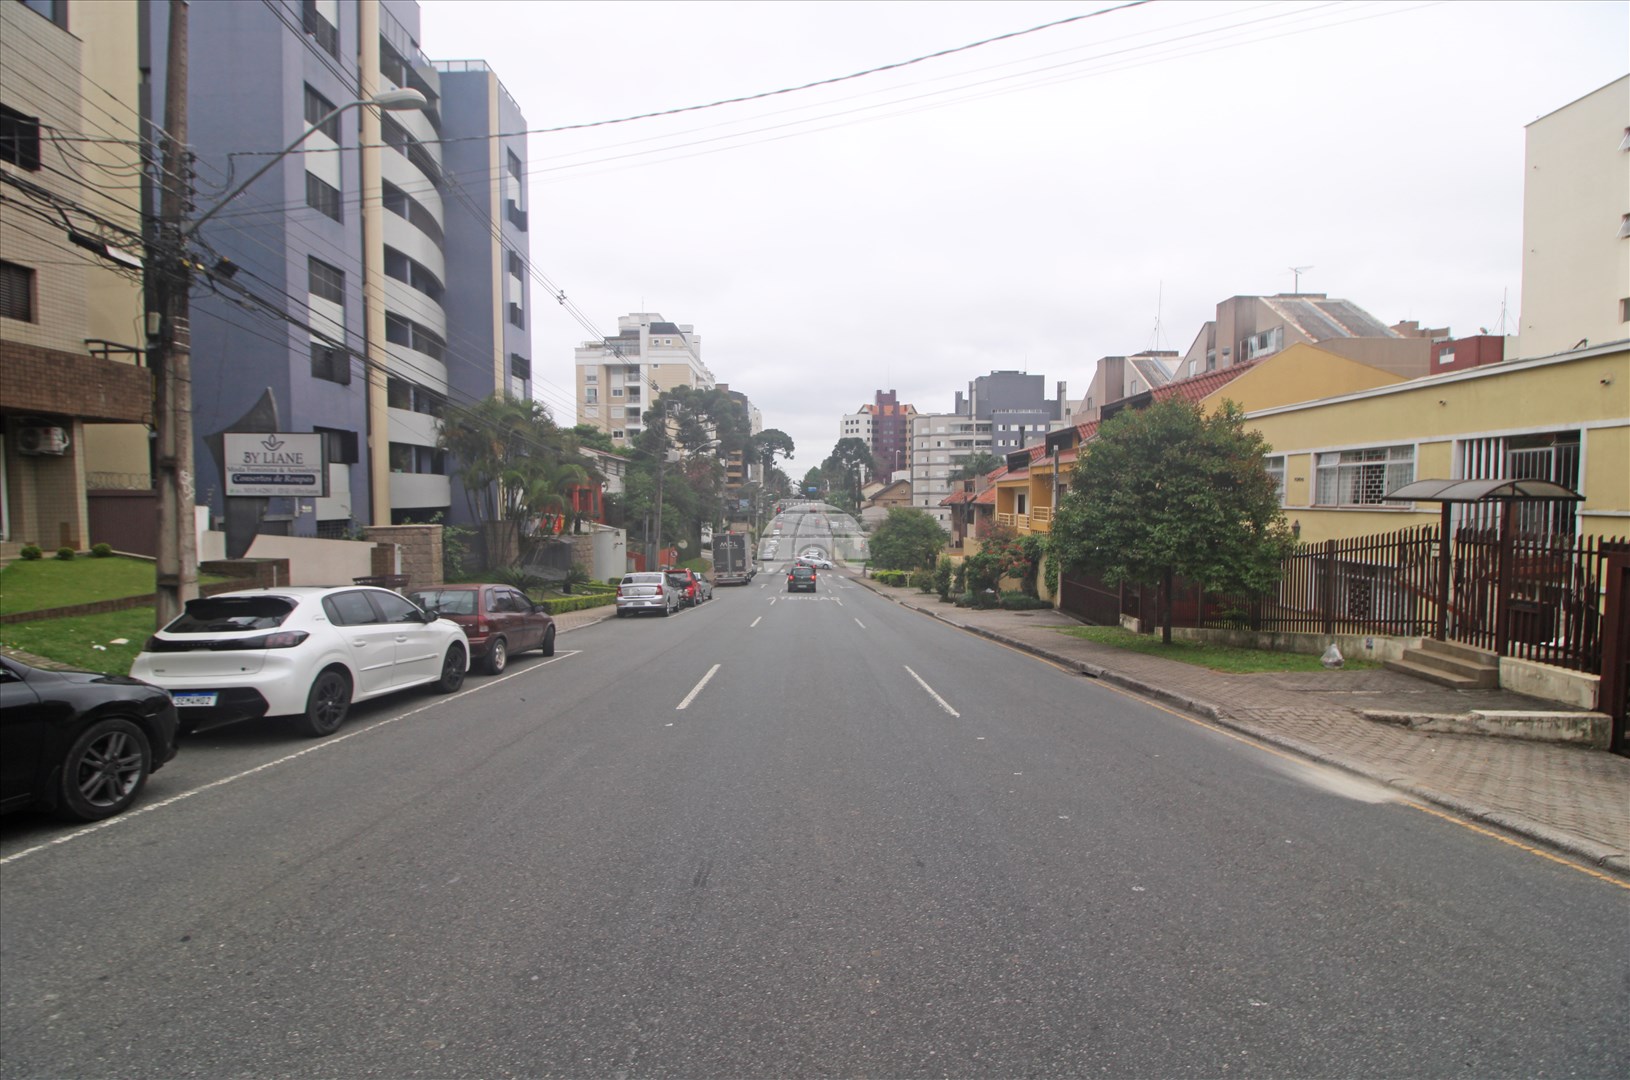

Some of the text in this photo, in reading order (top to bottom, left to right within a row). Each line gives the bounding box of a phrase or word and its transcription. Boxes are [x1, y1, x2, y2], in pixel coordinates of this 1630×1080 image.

[243, 452, 304, 464] BY LIANE
[233, 474, 314, 485] Consertos de Roupas
